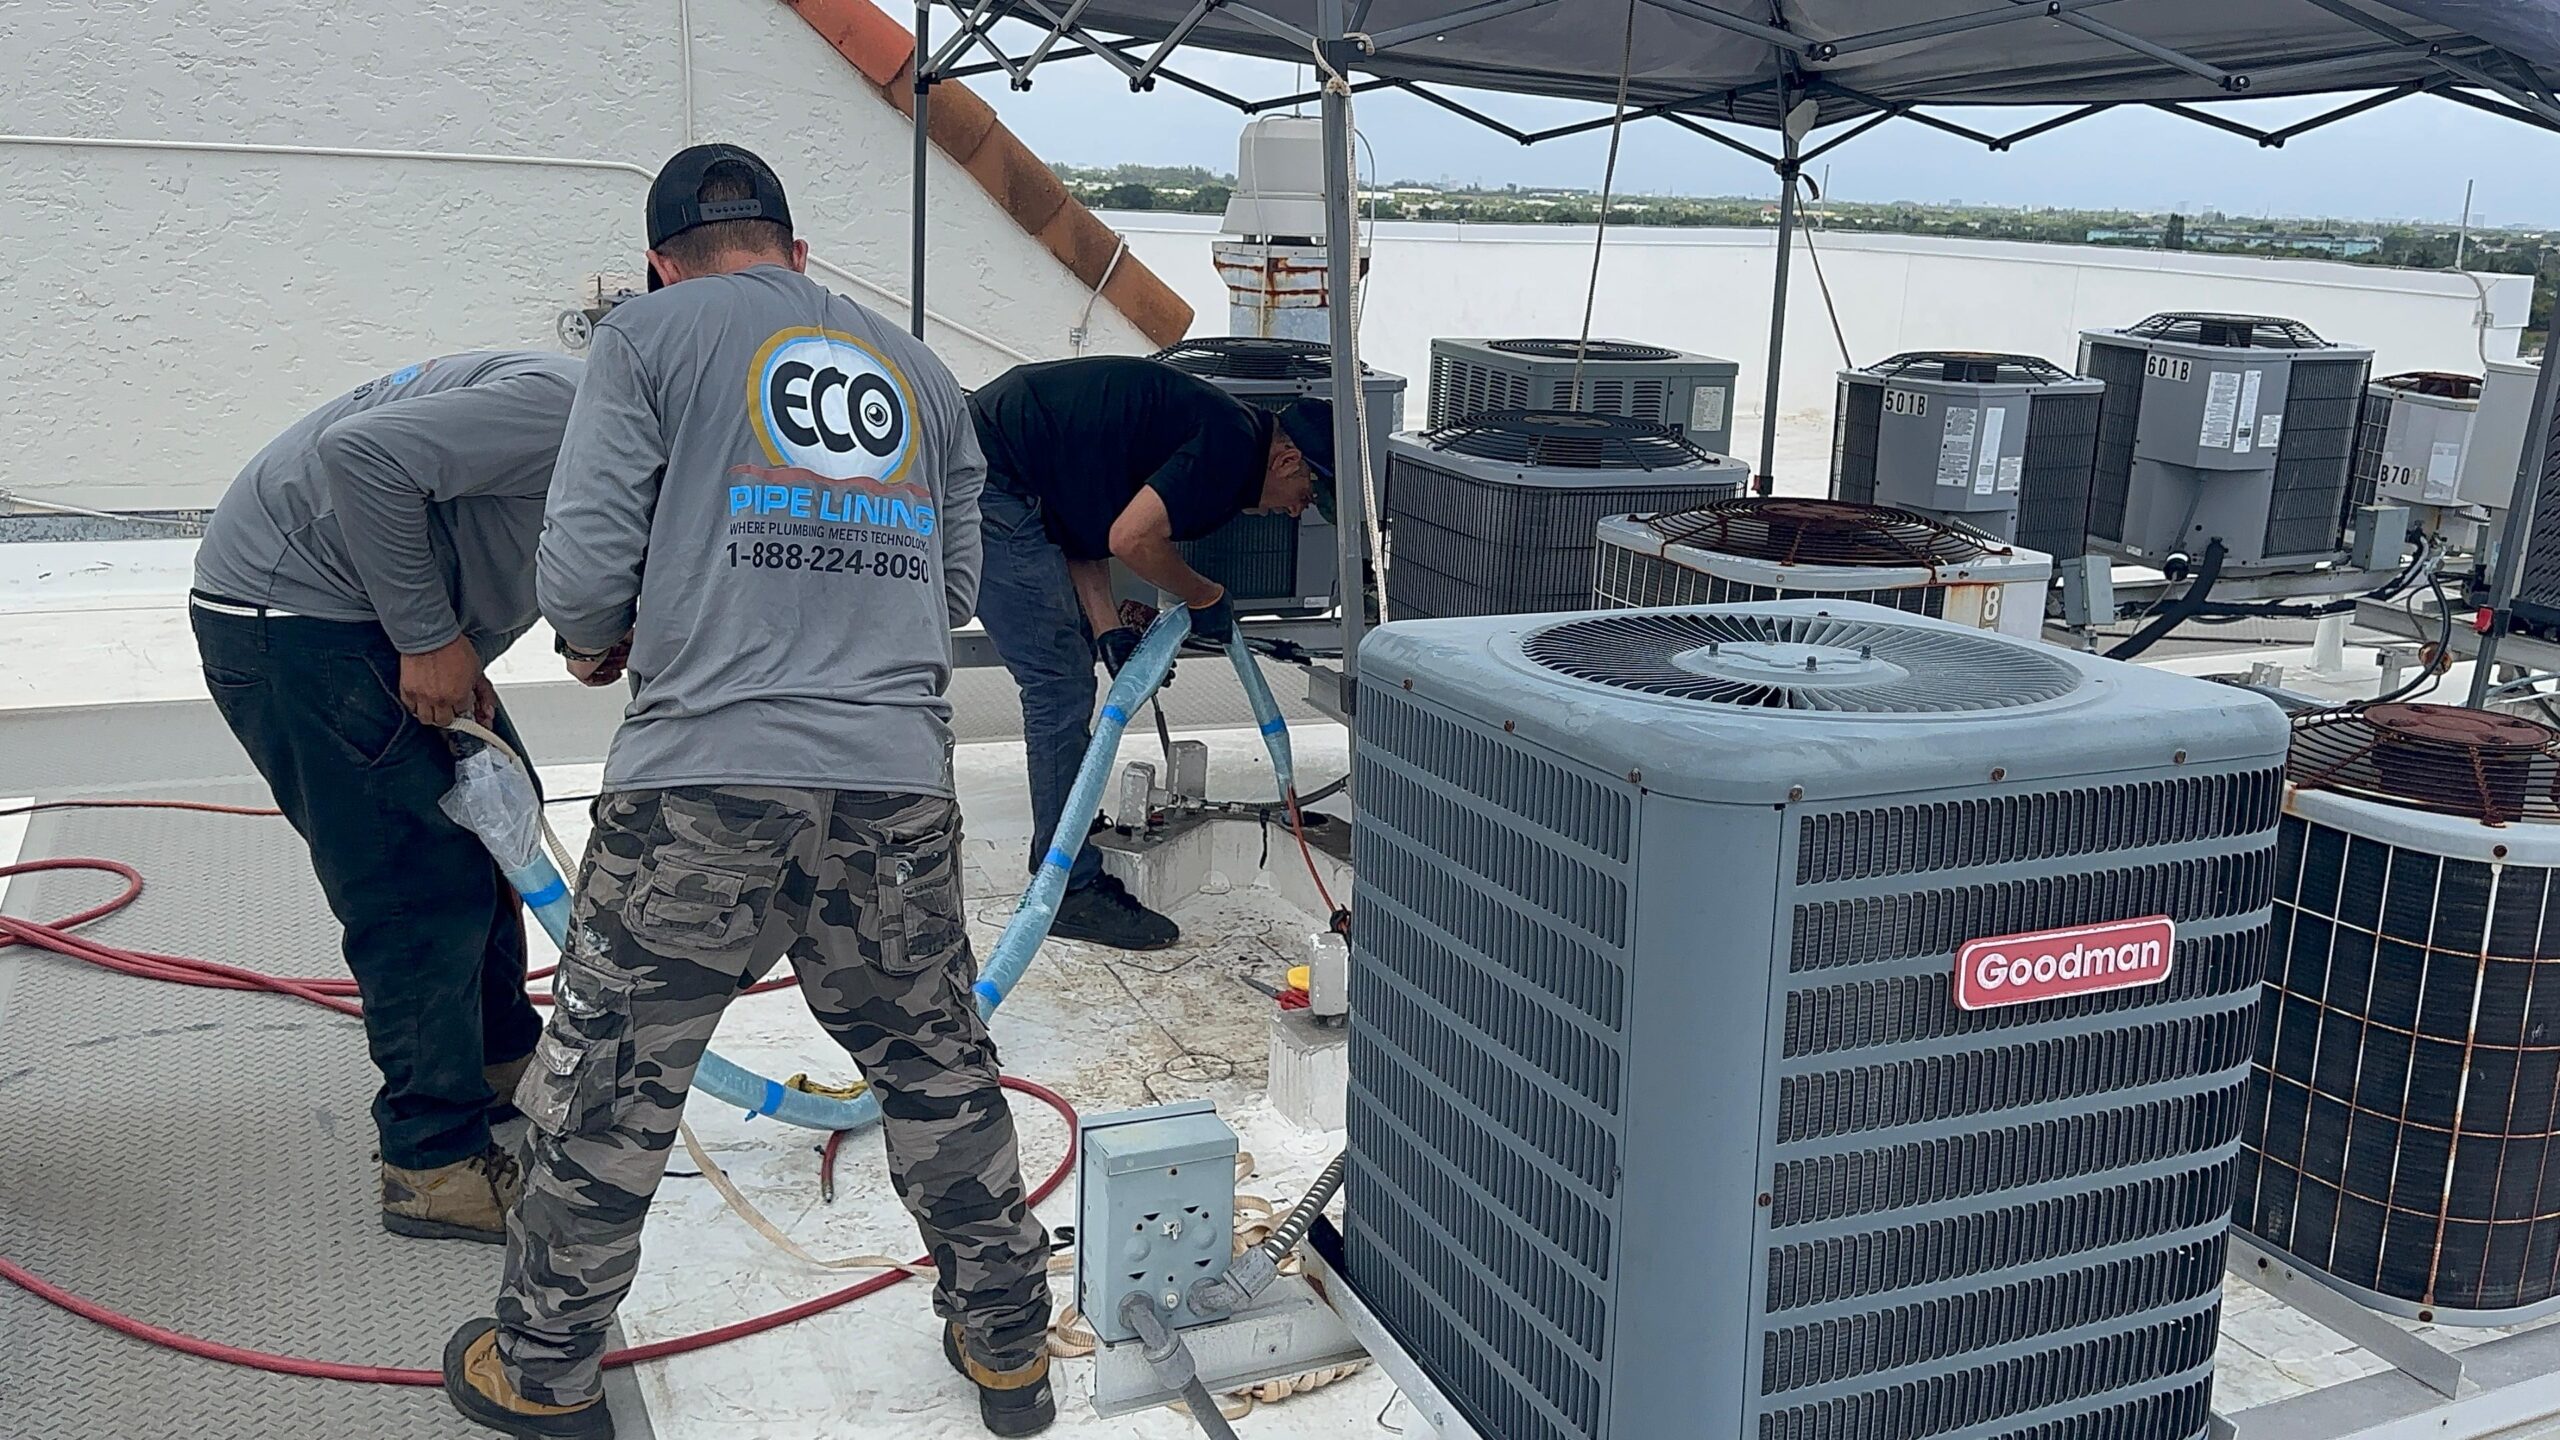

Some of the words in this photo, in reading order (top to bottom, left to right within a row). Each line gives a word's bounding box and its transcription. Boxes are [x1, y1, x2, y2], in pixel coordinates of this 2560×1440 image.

[2148, 356, 2189, 380] 601B
[770, 361, 903, 457] ECO
[1885, 391, 1925, 415] 501B
[728, 485, 813, 518] PIPE
[819, 490, 935, 536] LINING
[730, 521, 765, 535] WHERE
[769, 522, 825, 538] PLUMBING
[828, 528, 868, 543] MEETS
[726, 542, 929, 584] 1-888-224-8090
[1976, 939, 2160, 990] Goodman
